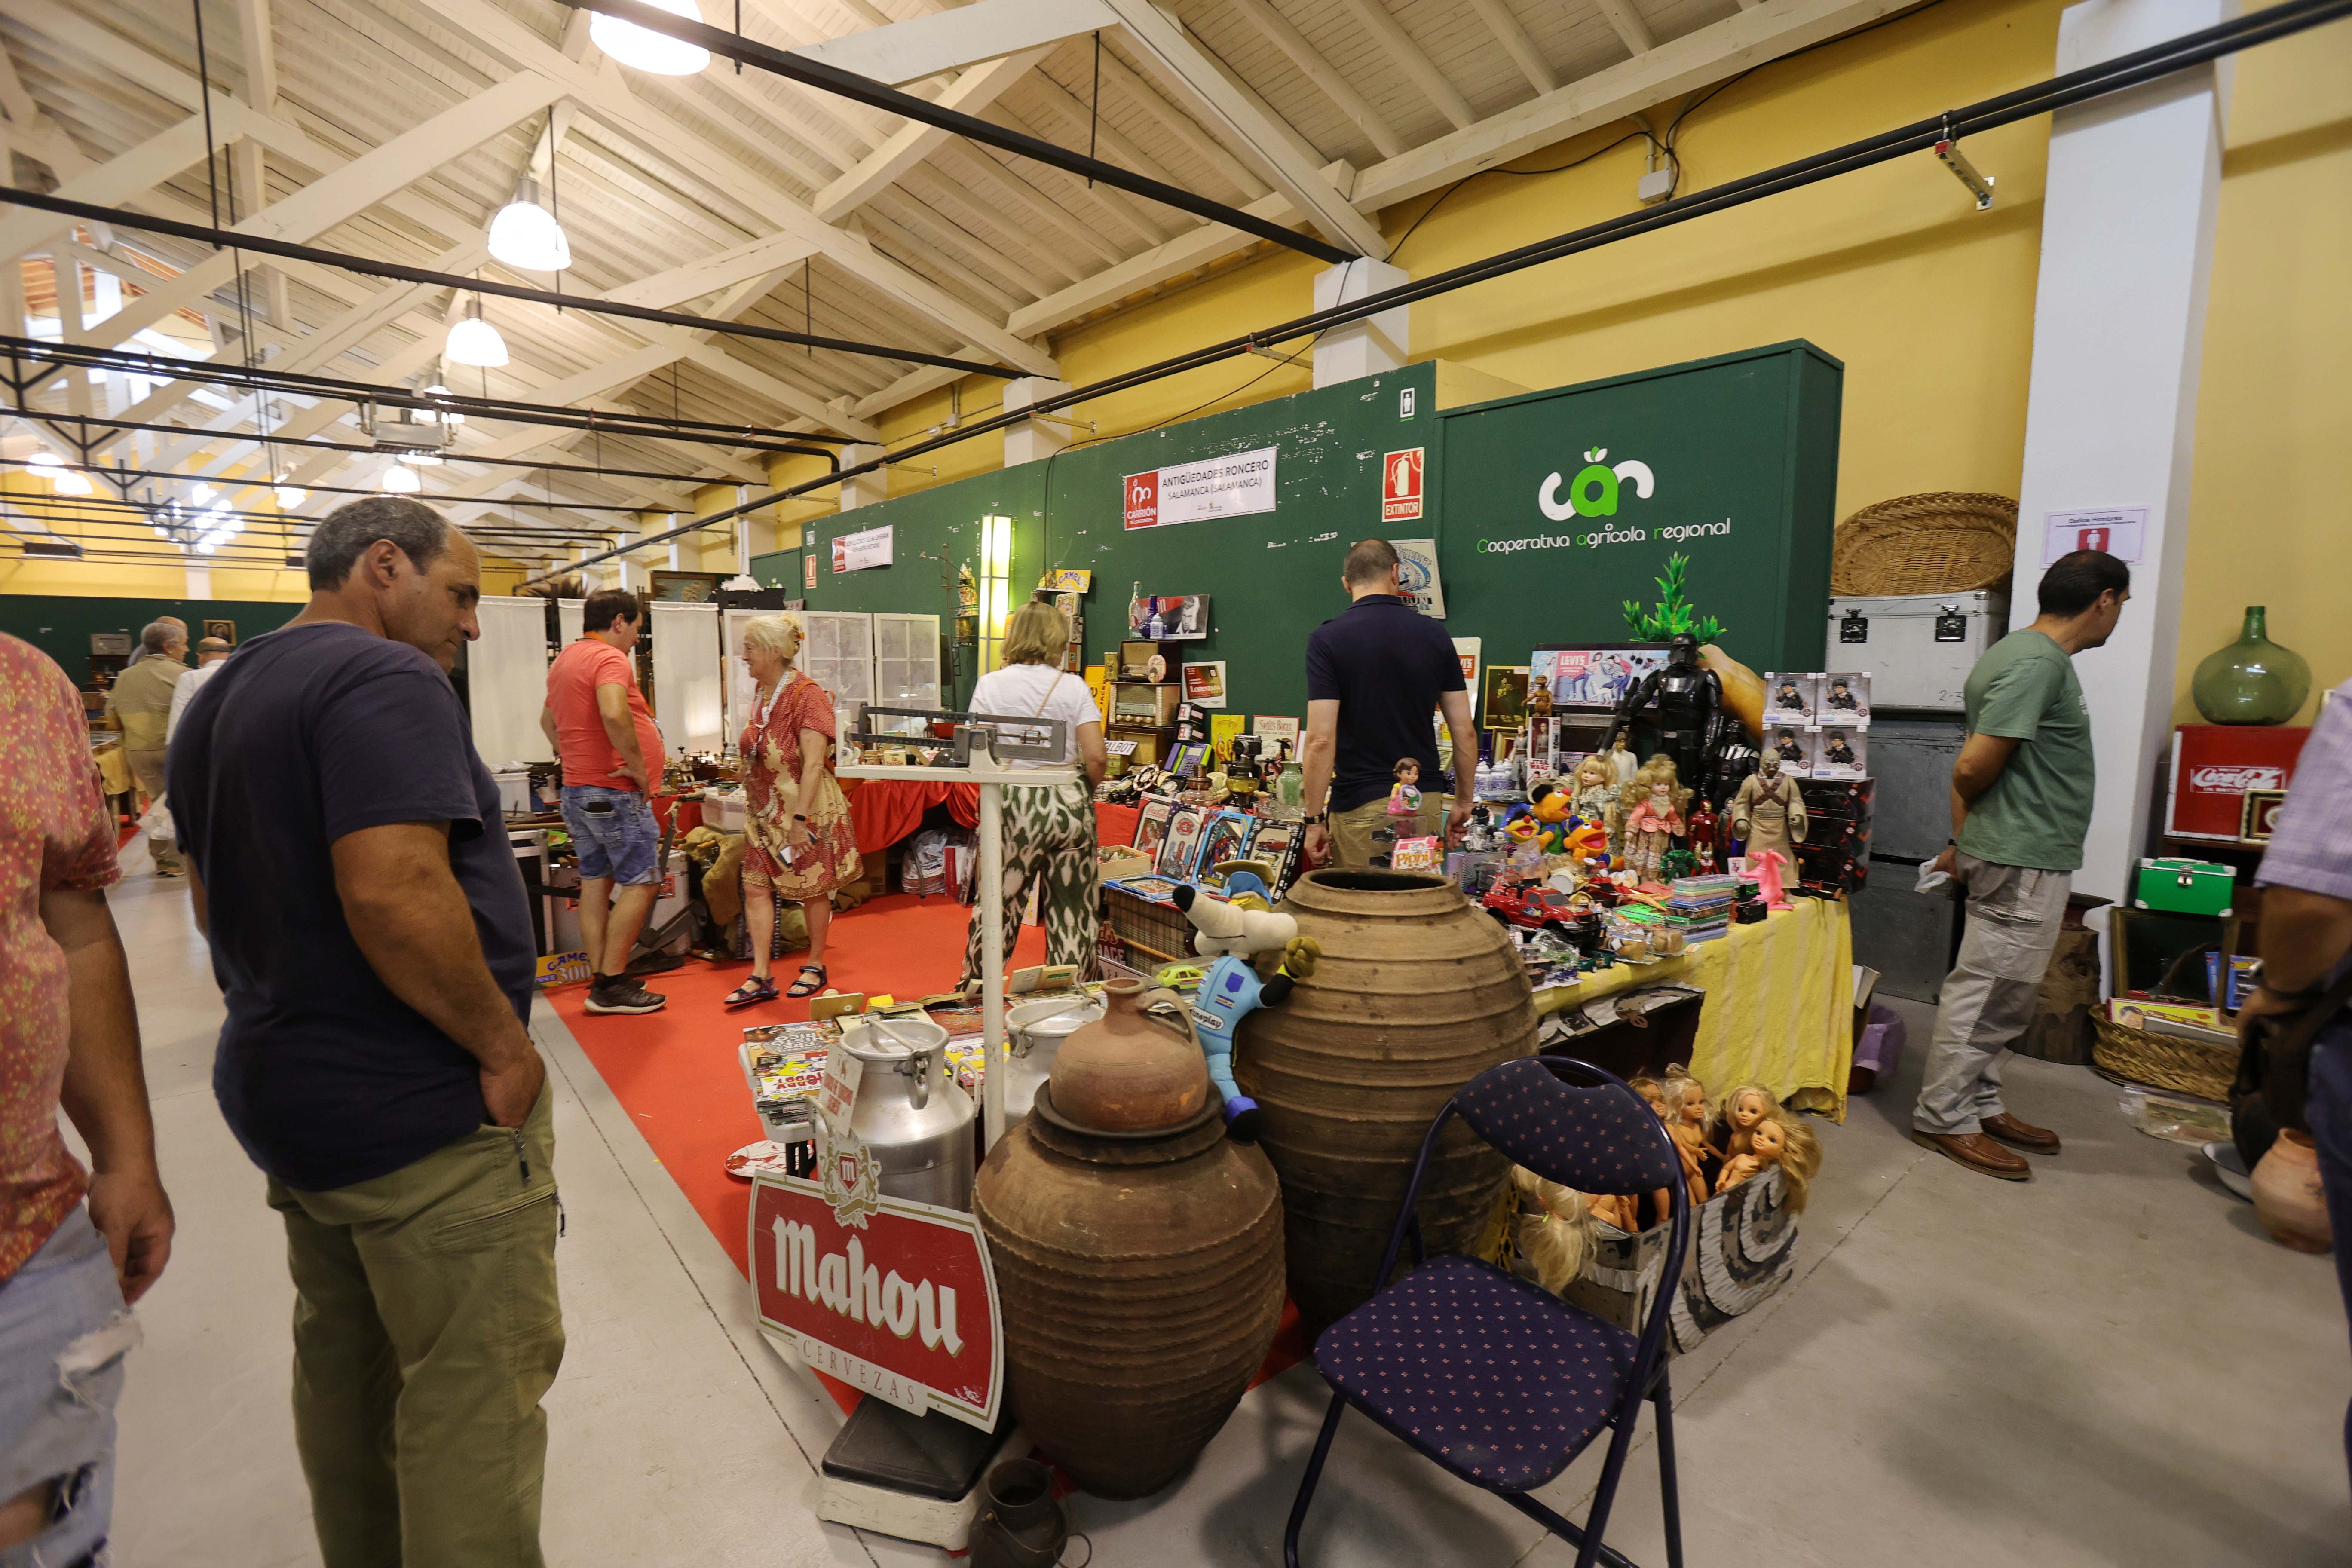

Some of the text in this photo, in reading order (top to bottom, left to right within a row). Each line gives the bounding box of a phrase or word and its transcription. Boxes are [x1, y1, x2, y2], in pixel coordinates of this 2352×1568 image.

[1162, 460, 1269, 488] ANTIGÜEDADES RONCERO
[1168, 477, 1262, 500] SALAMANCA (SALAMANCA)
[1127, 506, 1157, 519] CARRIÓN
[1385, 502, 1419, 516] EXTINTOR
[1477, 534, 1570, 555] Cooperativa
[1654, 517, 1731, 542] regional
[1560, 655, 1586, 666] LEVI'S
[1106, 742, 1136, 753] ALBOT
[1396, 851, 1429, 867] Pippi
[547, 952, 590, 971] CAME
[557, 963, 592, 984] 300
[770, 1036, 824, 1046] HISTO
[775, 1032, 816, 1041] RICO
[771, 1214, 965, 1359] Mahou
[803, 1340, 915, 1405] CERVEZAS
